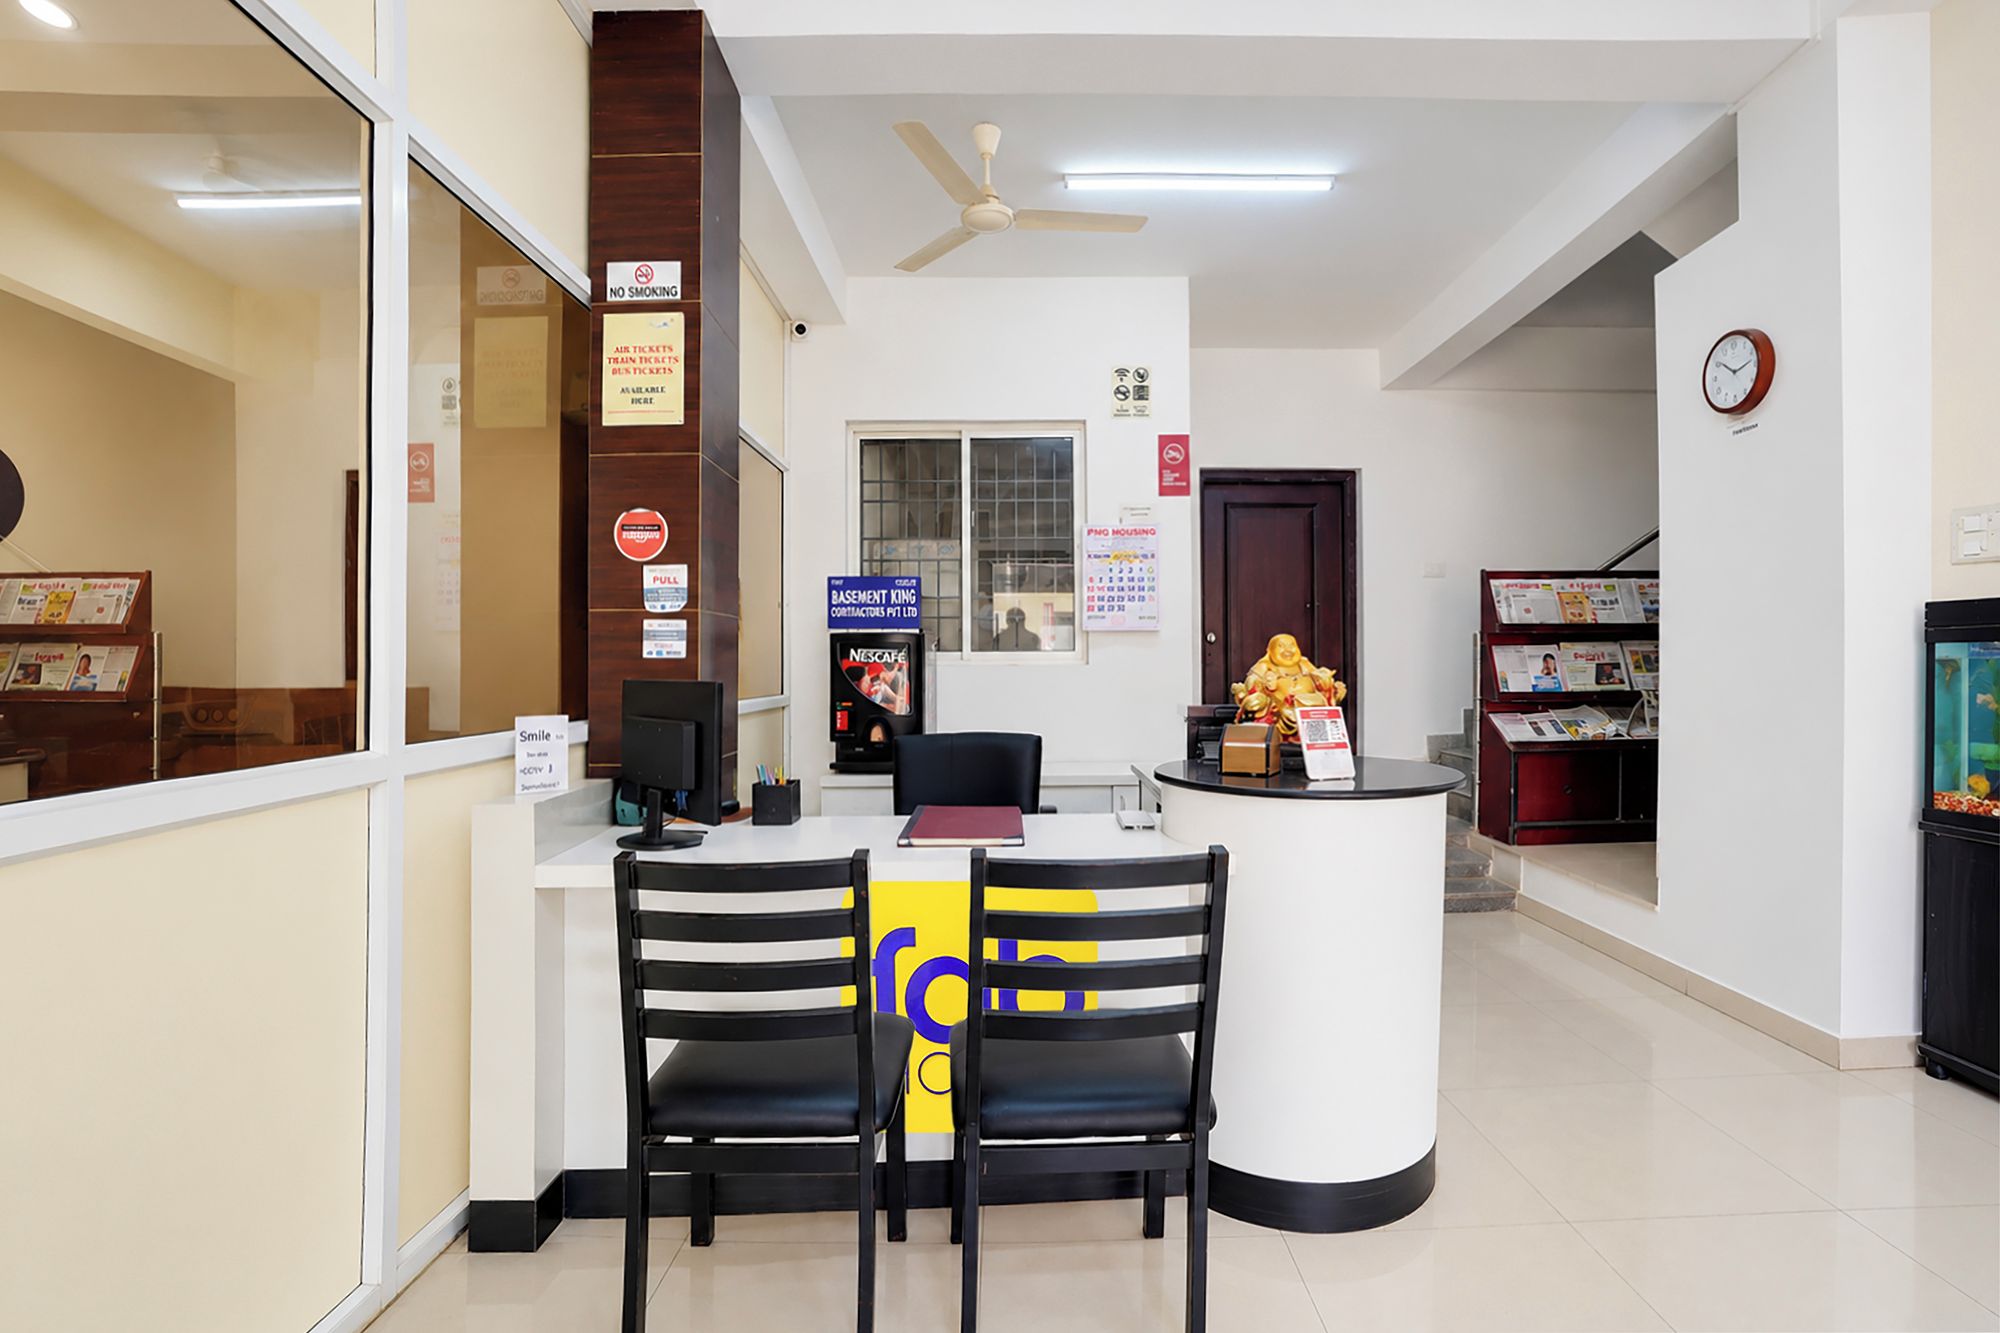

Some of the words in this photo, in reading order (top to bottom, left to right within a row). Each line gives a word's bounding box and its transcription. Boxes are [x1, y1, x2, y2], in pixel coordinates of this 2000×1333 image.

[610, 286, 625, 299] NO
[628, 285, 678, 299] SMOKING
[614, 345, 630, 354] AIR
[633, 344, 673, 354] TICKETS
[607, 356, 636, 365] TRAIN
[639, 355, 679, 364] TICKETS
[612, 367, 631, 376] BUS
[633, 366, 673, 376] TICKETS
[620, 386, 666, 394] AVAILABLE
[653, 575, 679, 585] PULL
[831, 589, 888, 605] BASEMENT
[890, 588, 916, 605] KING
[903, 606, 918, 618] LTD
[519, 729, 551, 743] Smile
